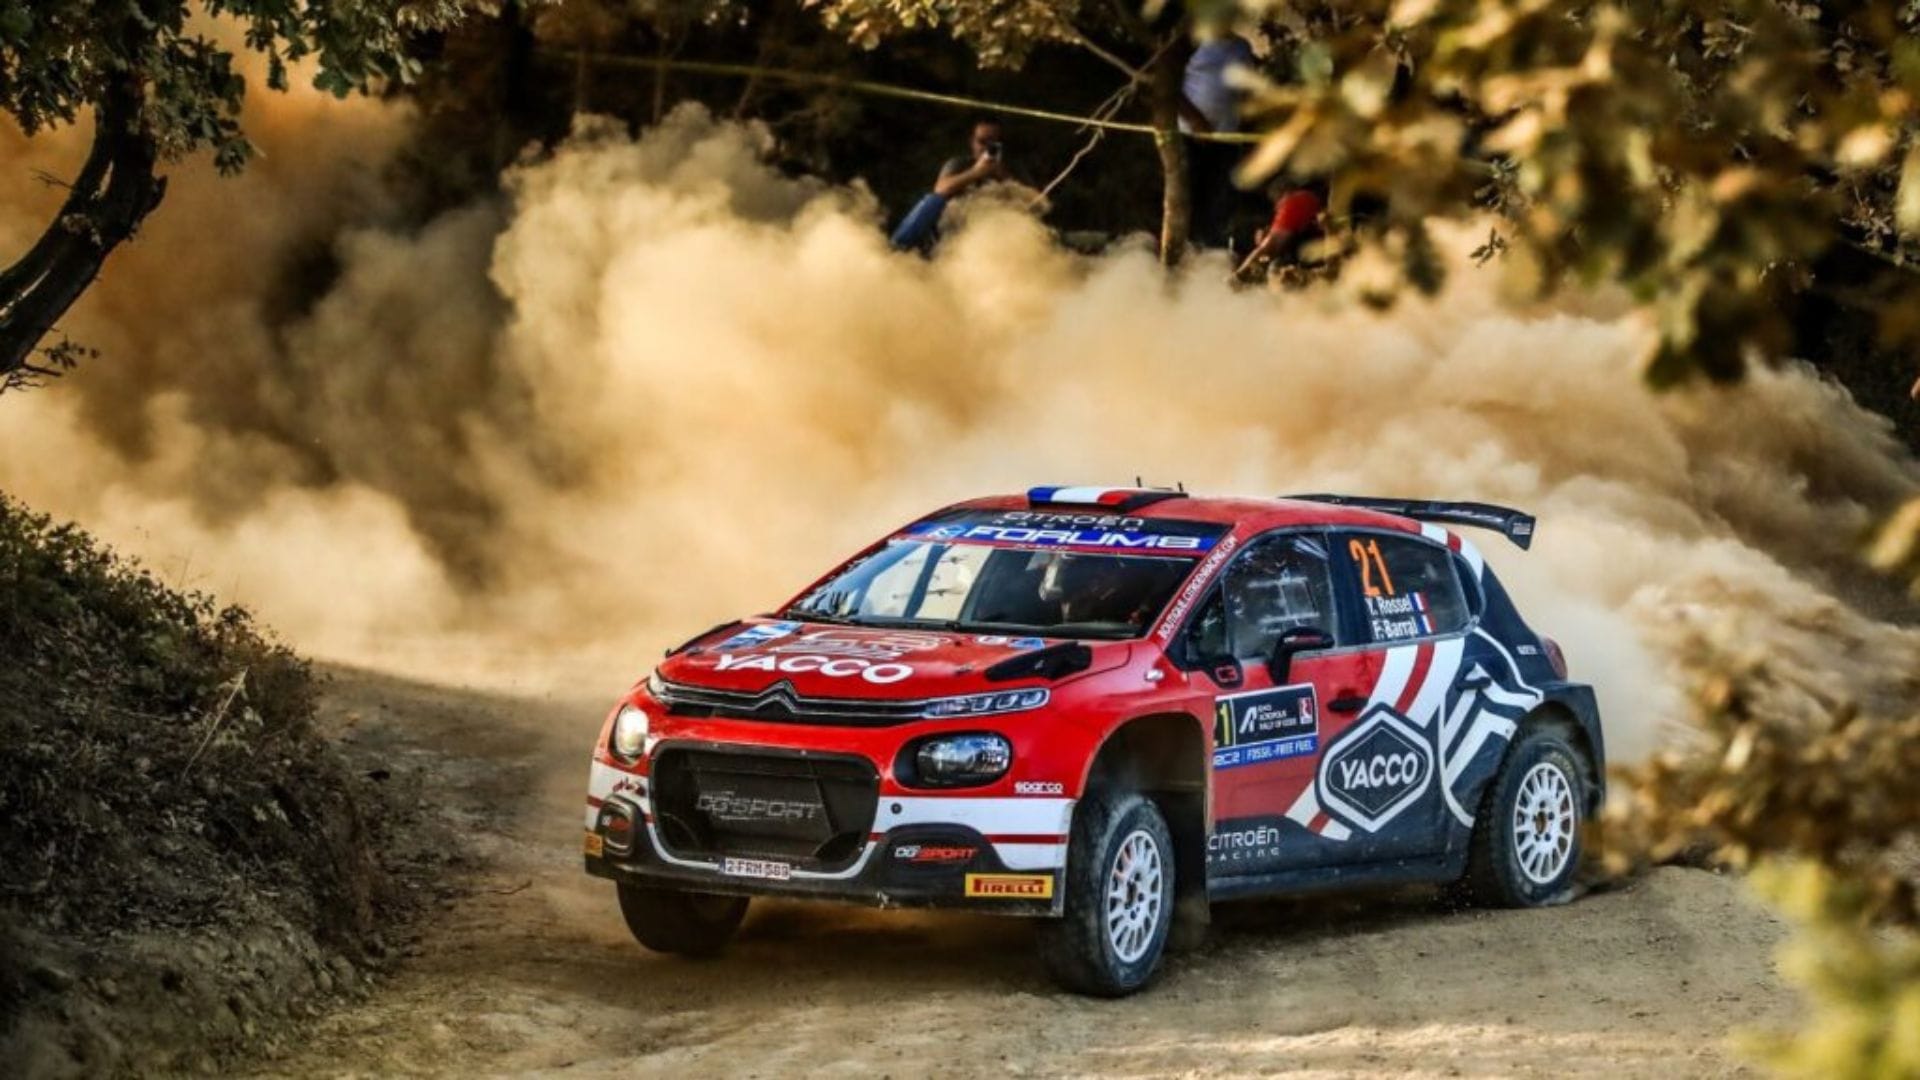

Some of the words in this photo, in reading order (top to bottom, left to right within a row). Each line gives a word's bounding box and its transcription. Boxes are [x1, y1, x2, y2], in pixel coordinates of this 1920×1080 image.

[964, 525, 1200, 549] FORUM8
[1349, 539, 1394, 596] 21
[1378, 594, 1414, 614] Rossel
[1384, 614, 1418, 638] Barral
[714, 653, 913, 684] YACCO
[1340, 753, 1418, 790] YACCO
[973, 878, 1045, 894] PIRELLI
